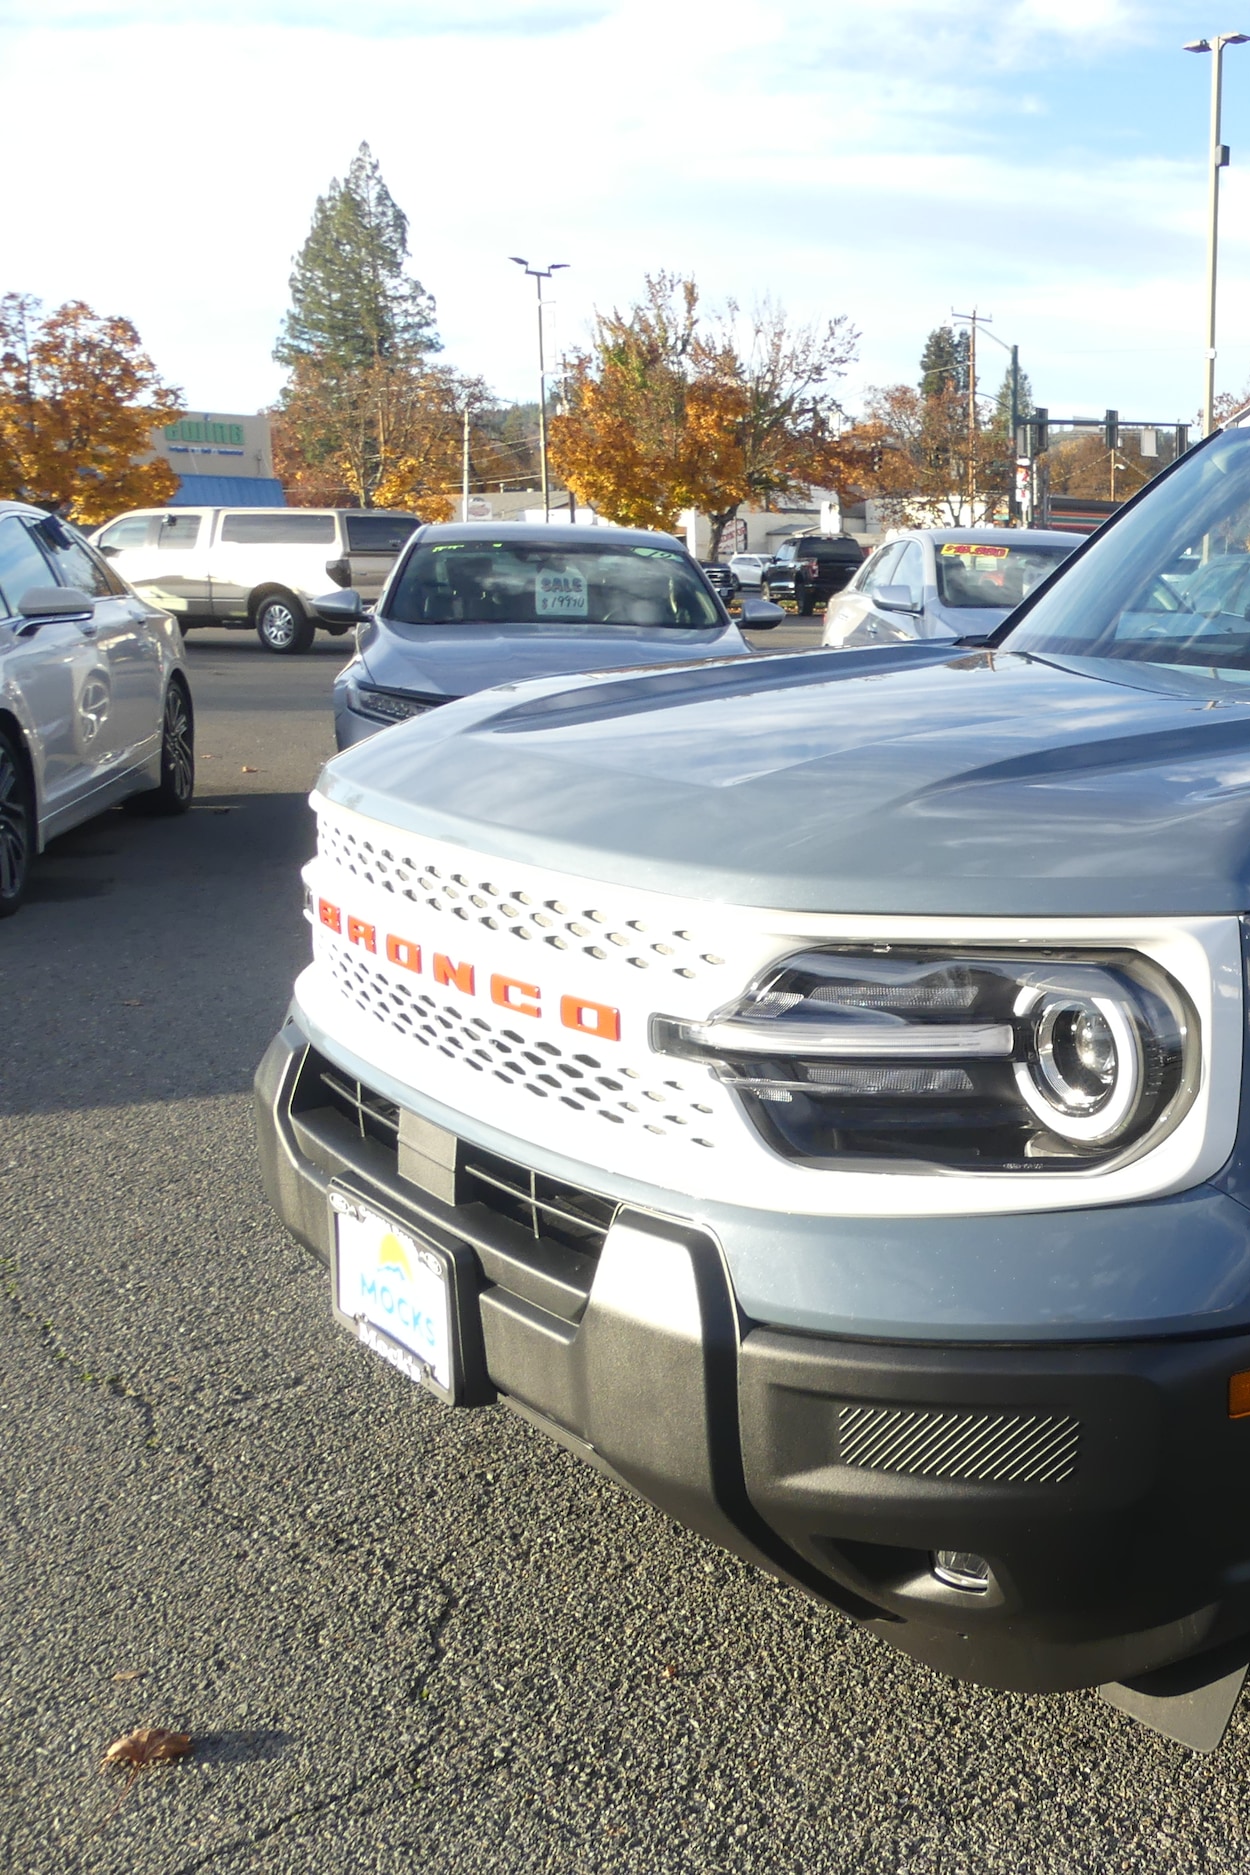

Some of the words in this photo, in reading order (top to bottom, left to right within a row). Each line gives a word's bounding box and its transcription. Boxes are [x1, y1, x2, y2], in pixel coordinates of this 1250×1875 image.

[541, 577, 583, 593] SALE
[318, 896, 621, 1042] BRONCO
[360, 1272, 436, 1347] MOCKS
